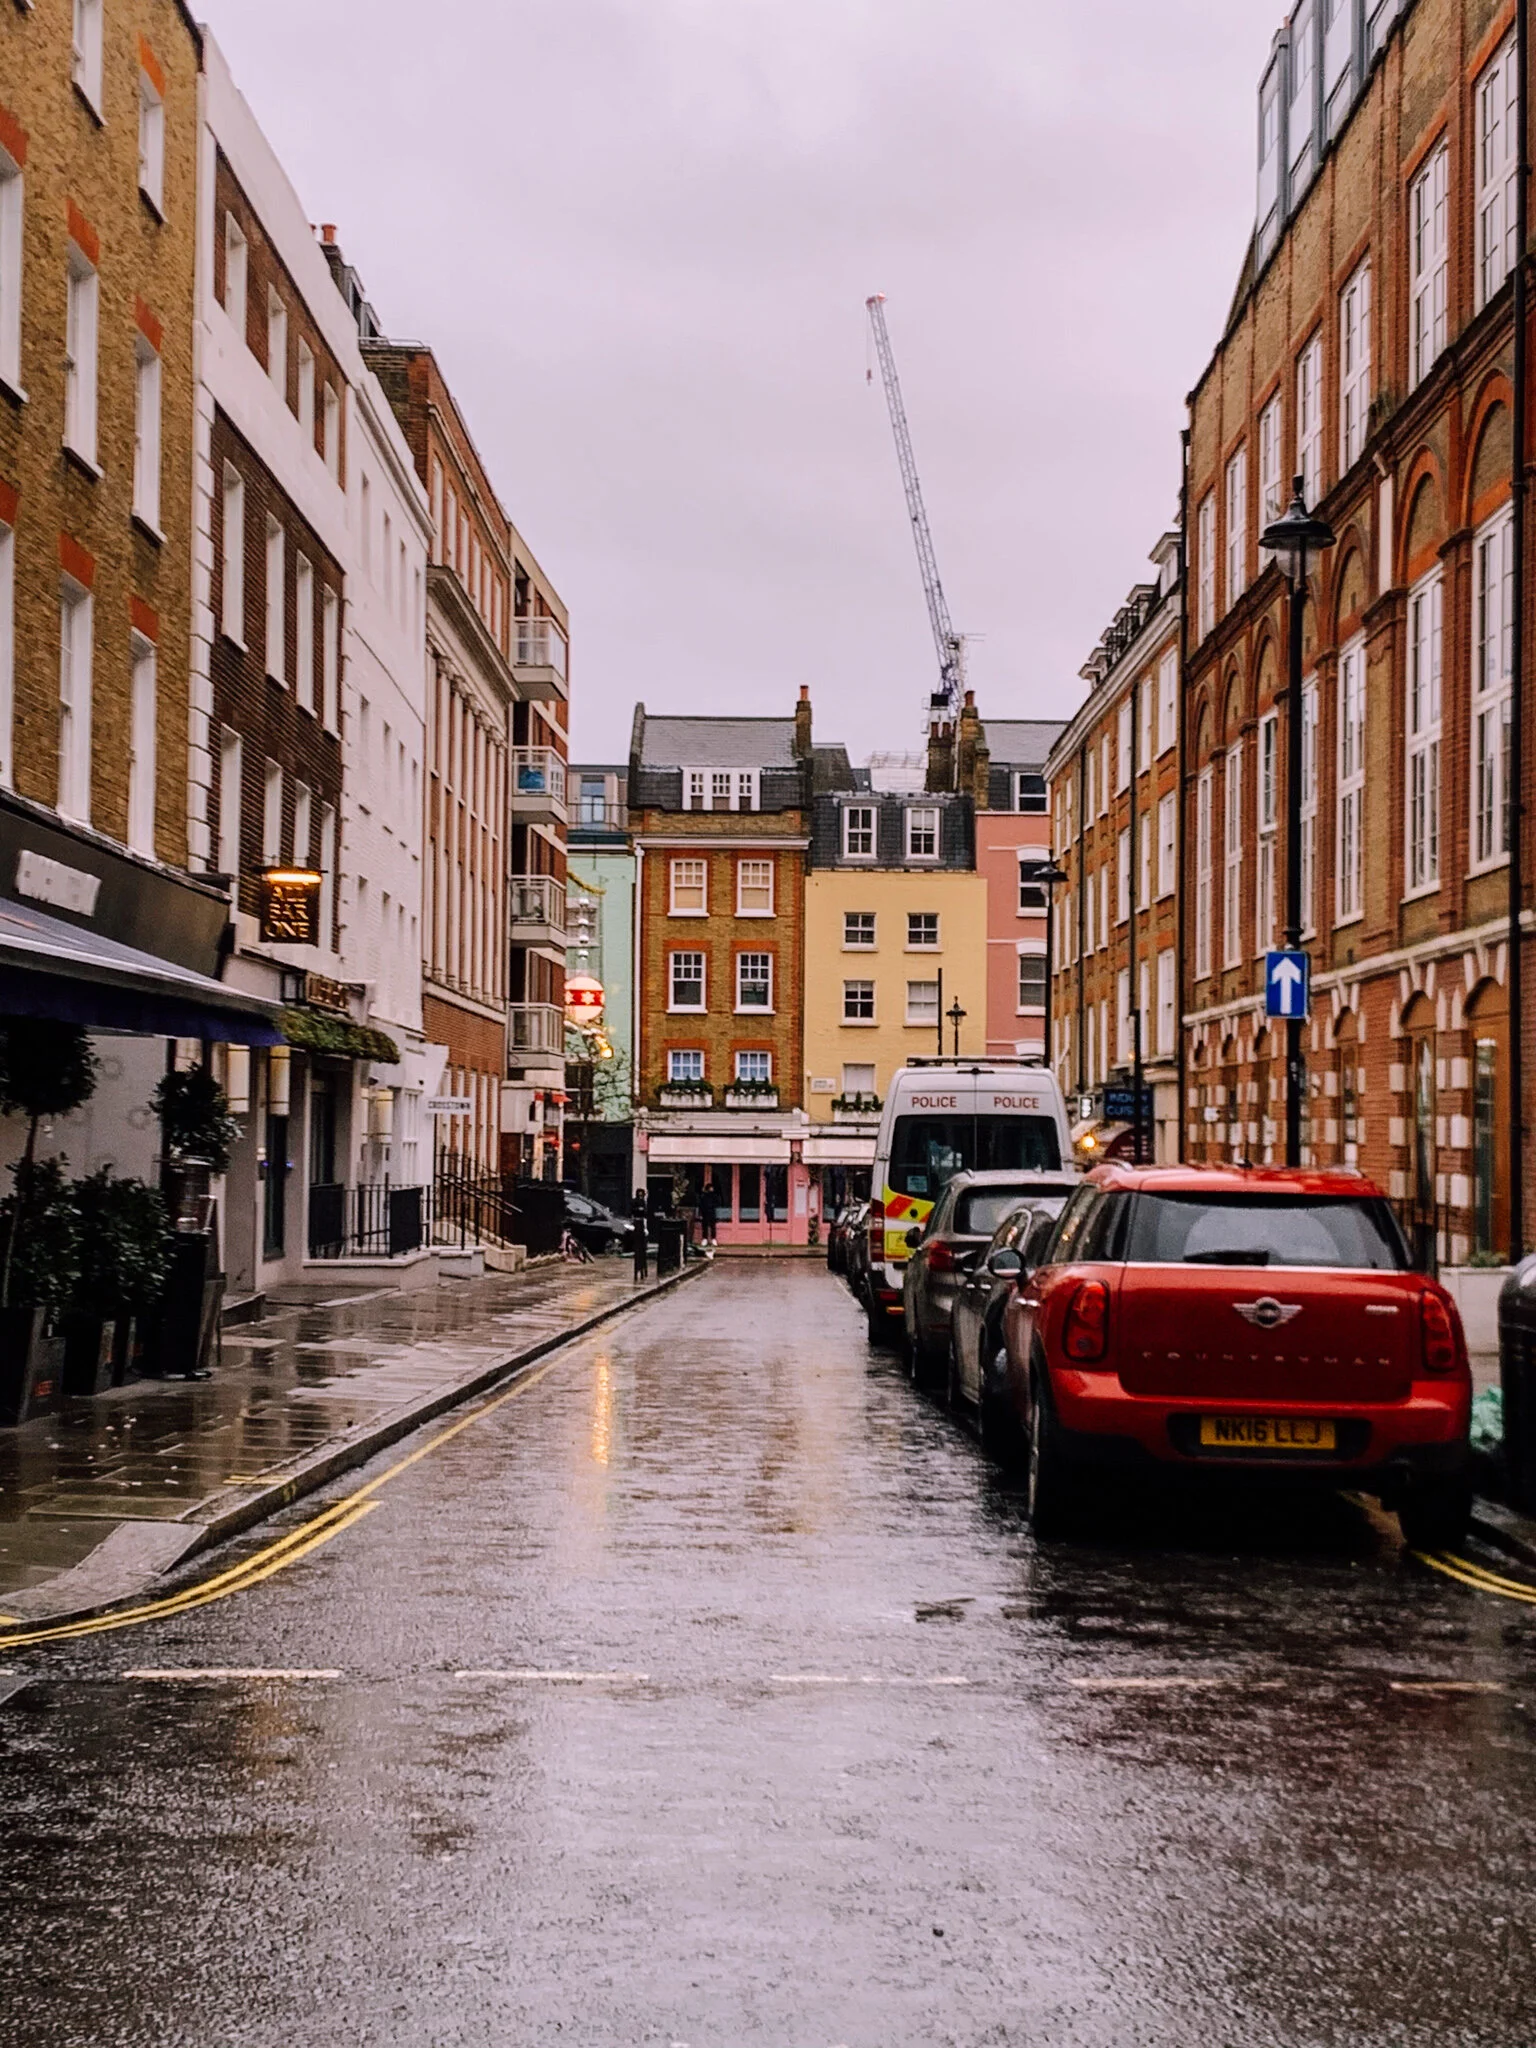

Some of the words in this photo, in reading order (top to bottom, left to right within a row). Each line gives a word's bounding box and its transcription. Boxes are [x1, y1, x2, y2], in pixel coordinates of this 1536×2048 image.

[271, 886, 307, 902] ALL
[269, 903, 309, 920] BAR
[264, 921, 310, 938] ONE
[911, 1096, 957, 1108] POLICE
[993, 1096, 1040, 1109] POLICE
[1142, 1350, 1391, 1366] COUNTRYMAN
[1215, 1418, 1268, 1442] NK16
[1274, 1419, 1320, 1444] LLJ
